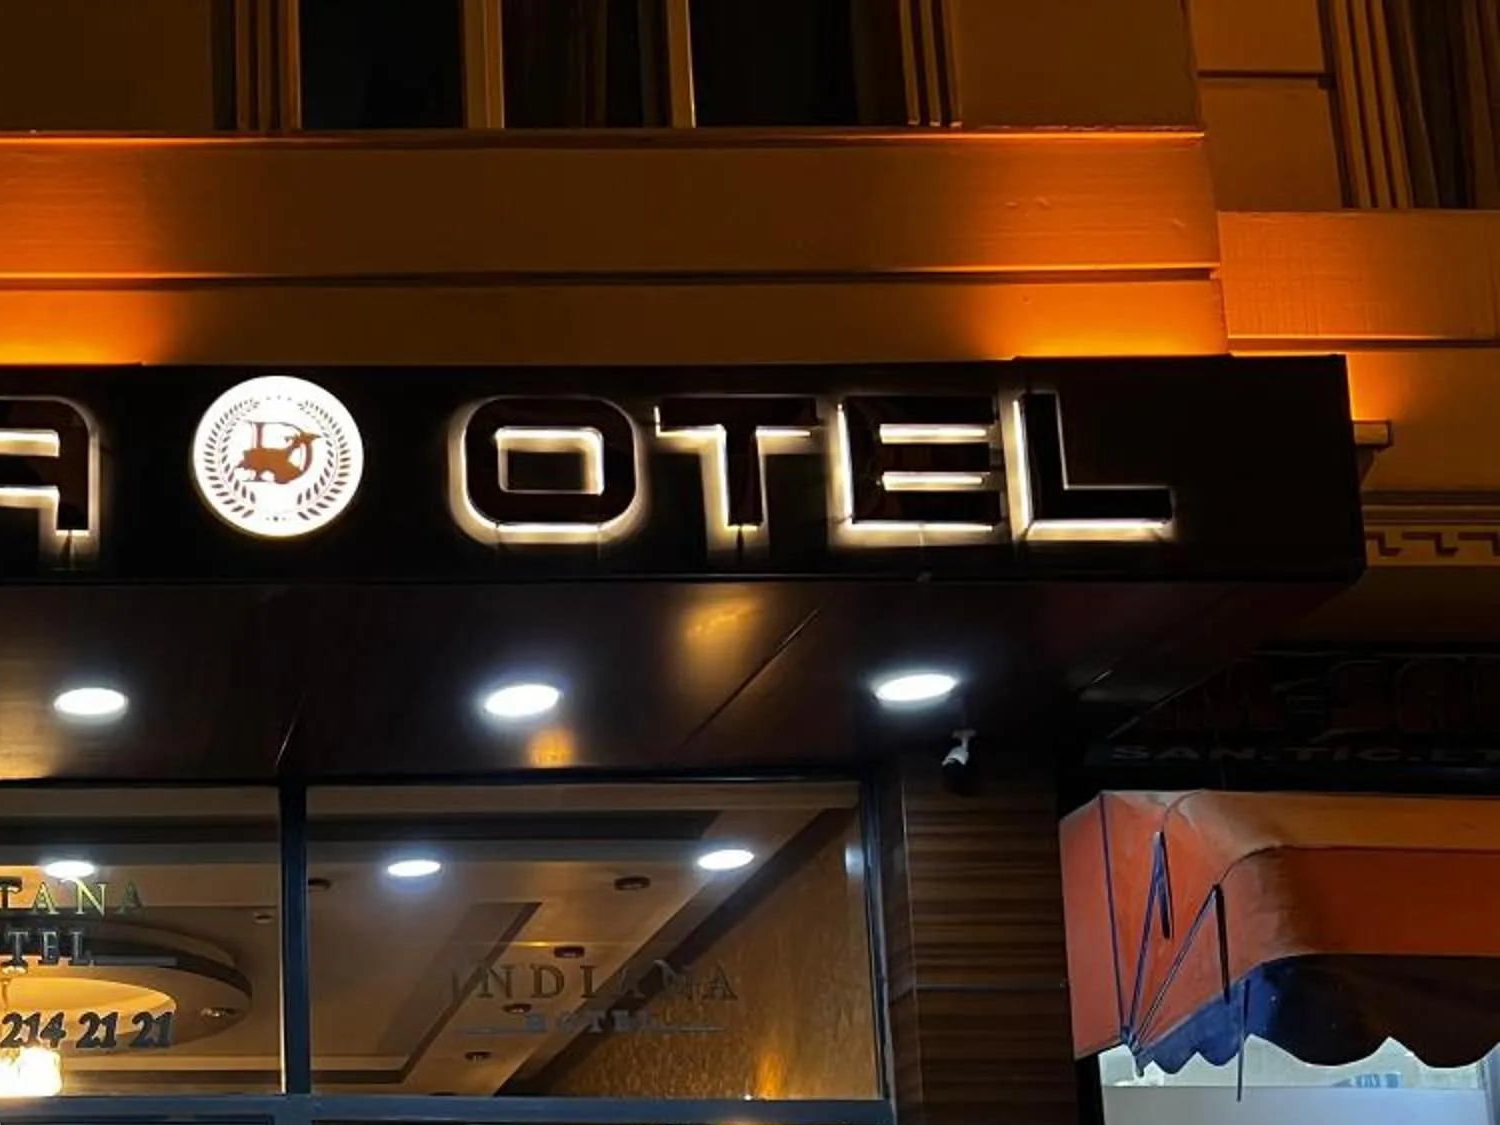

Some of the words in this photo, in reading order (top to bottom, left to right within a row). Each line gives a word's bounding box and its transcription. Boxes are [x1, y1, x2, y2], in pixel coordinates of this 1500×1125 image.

[448, 390, 1178, 552] OTEL
[450, 959, 739, 1001] INDIANA
[0, 1011, 67, 1050] 214
[76, 1011, 120, 1050] 21
[129, 1010, 175, 1050] 21
